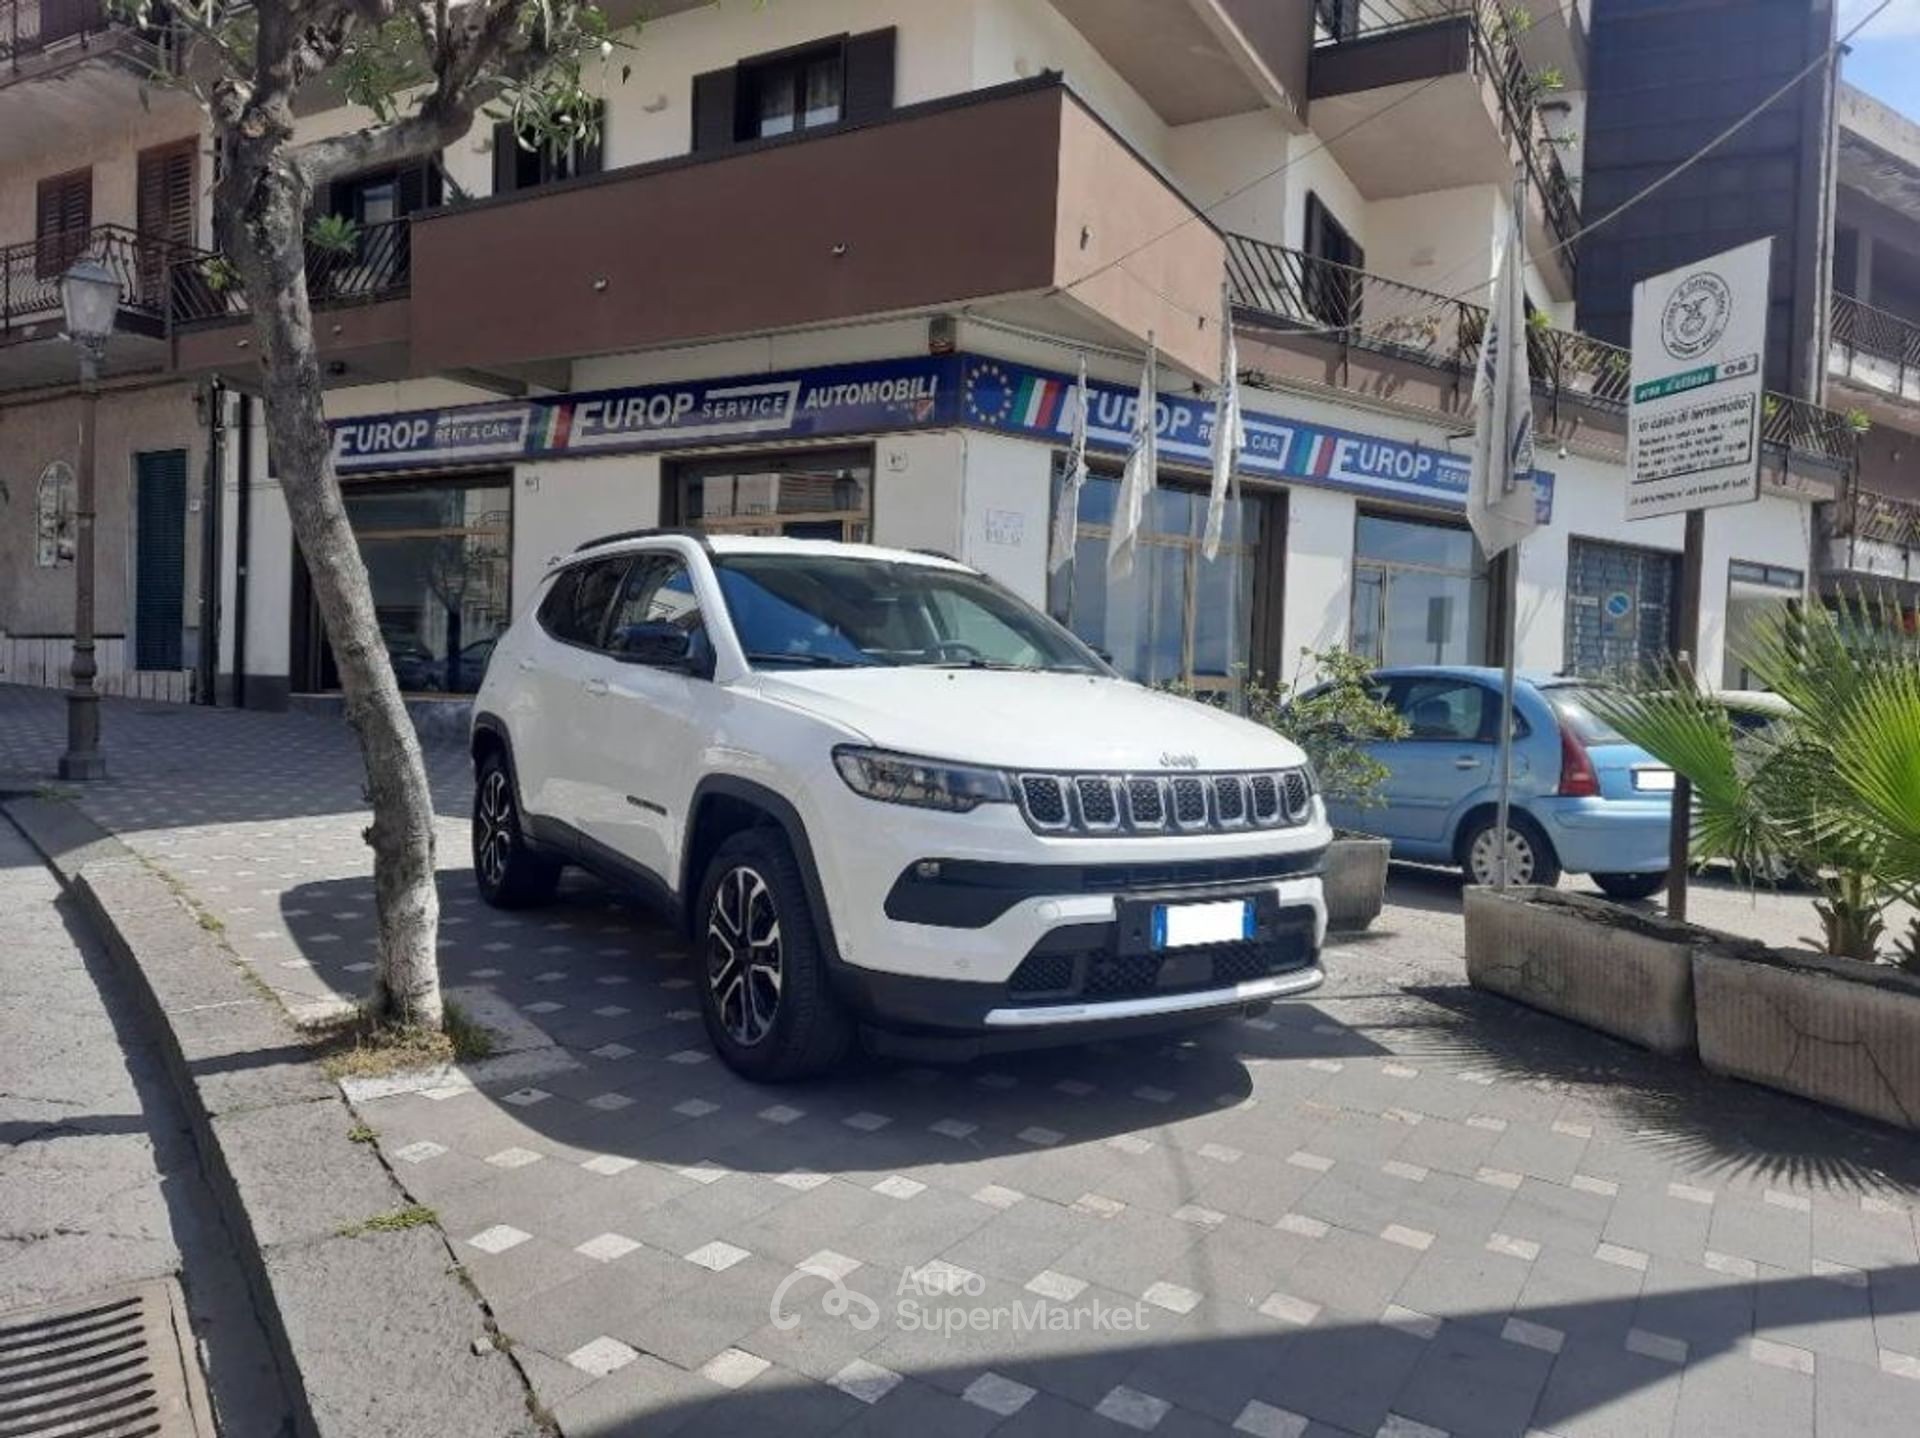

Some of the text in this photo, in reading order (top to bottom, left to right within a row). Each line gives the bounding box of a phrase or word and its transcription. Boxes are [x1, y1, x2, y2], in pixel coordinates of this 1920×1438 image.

[803, 375, 938, 409] AUTOMOBILI
[572, 392, 786, 437] EUROP SERVICE
[333, 419, 509, 463] EUROP RENT A CAR
[1252, 435, 1280, 452] CAR
[1328, 437, 1431, 480] EUROP
[1159, 751, 1199, 769] Jeep
